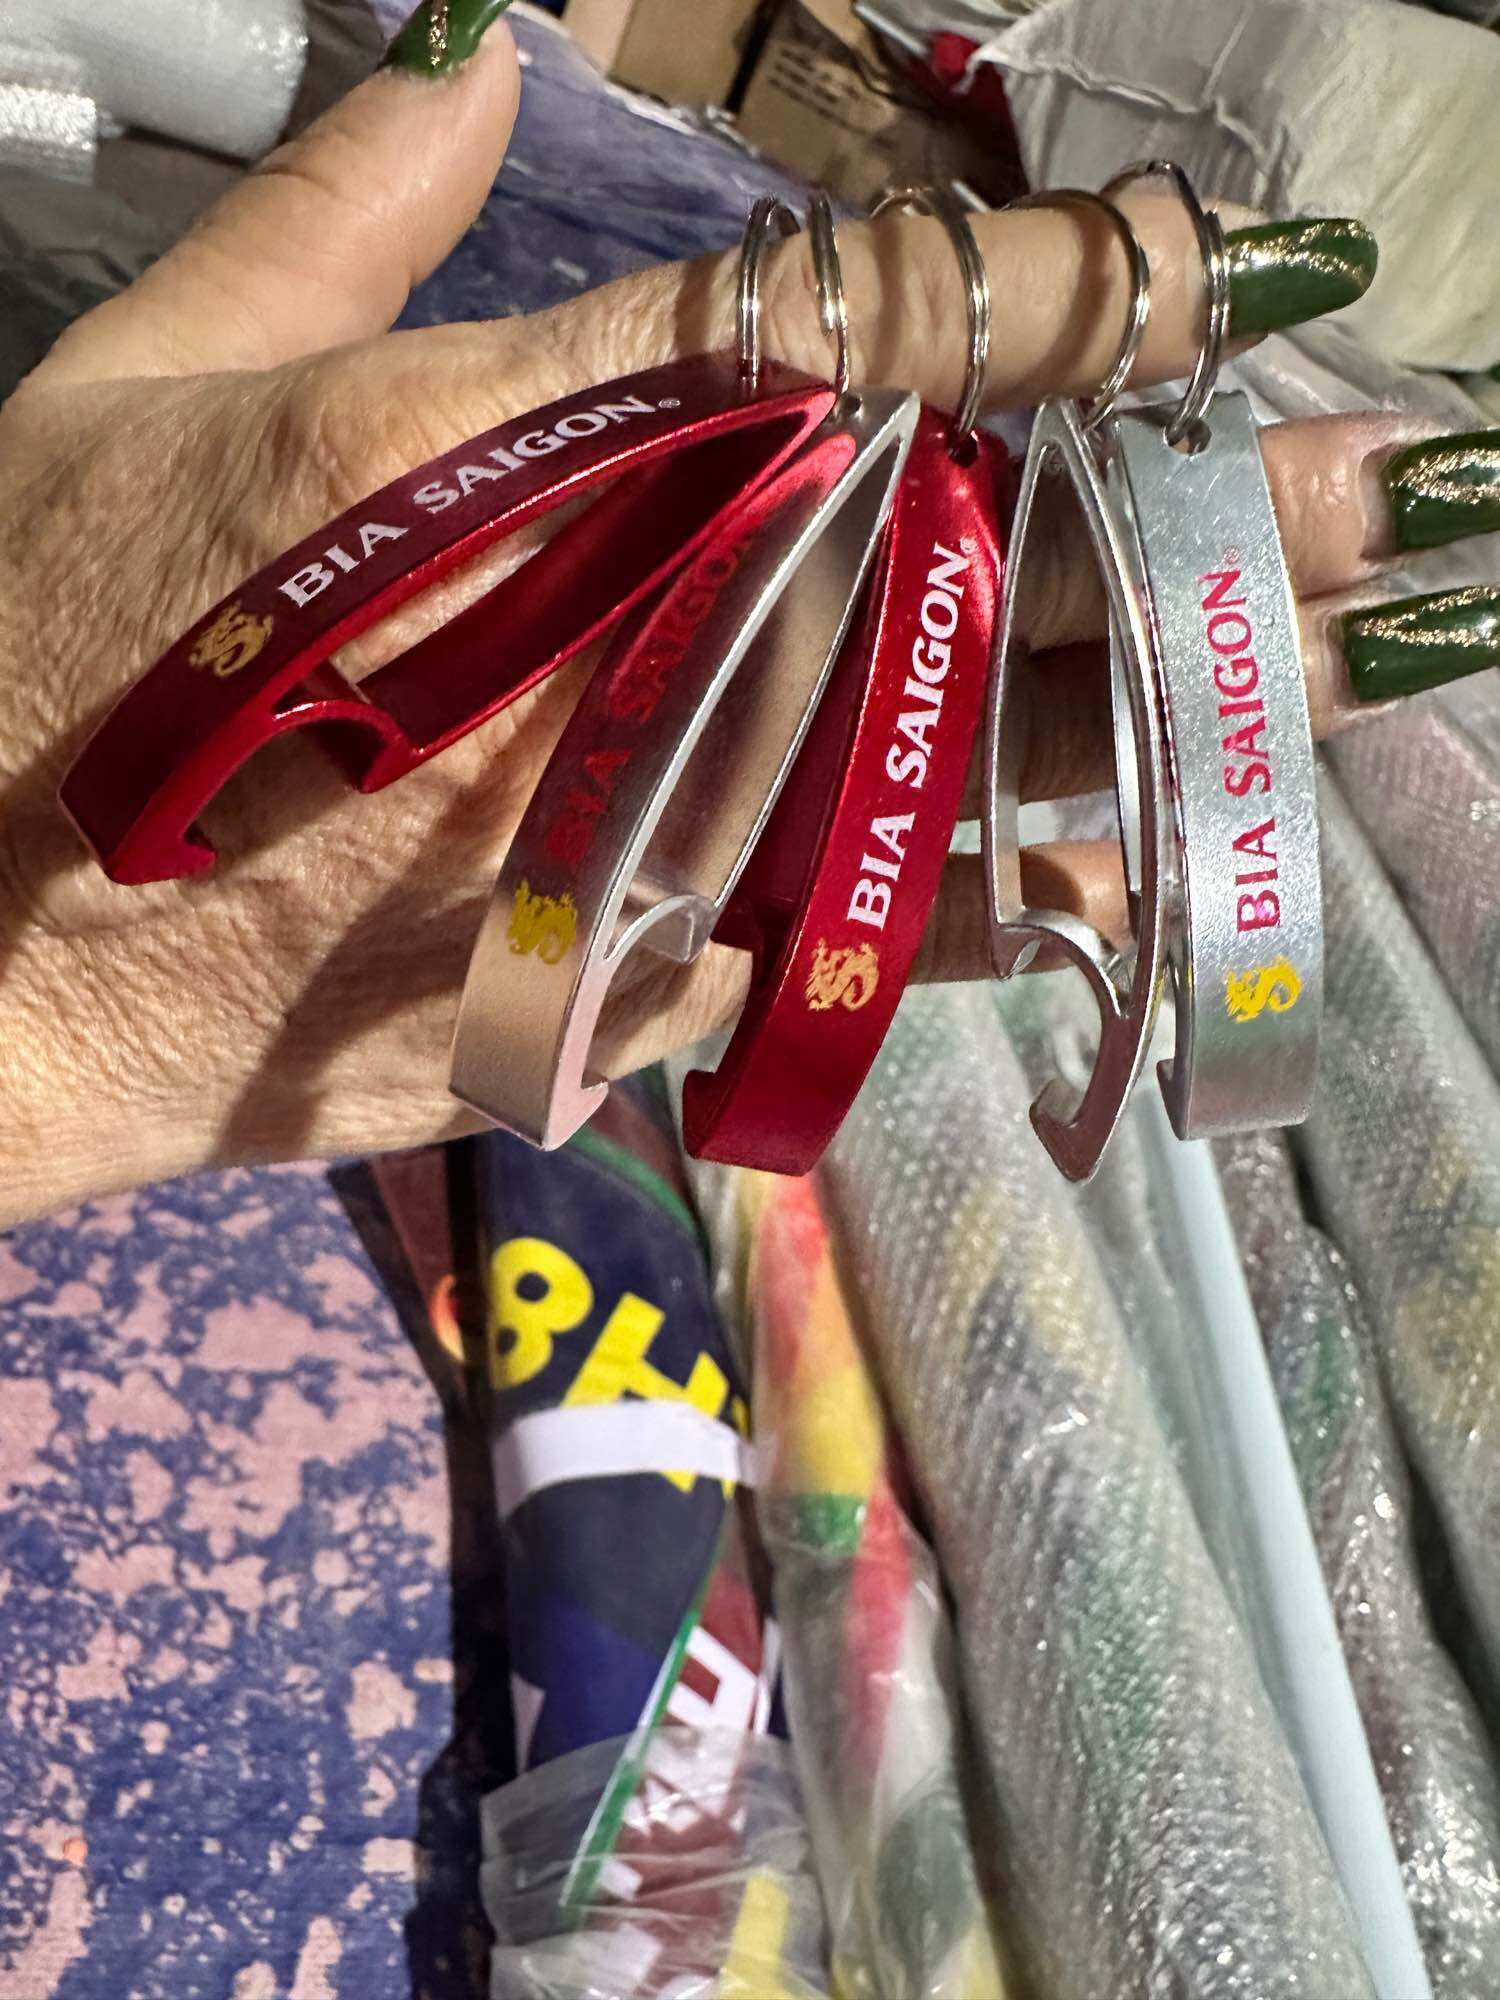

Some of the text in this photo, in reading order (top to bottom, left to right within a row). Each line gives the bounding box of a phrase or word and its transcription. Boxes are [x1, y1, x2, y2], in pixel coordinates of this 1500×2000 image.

[278, 521, 409, 607] BIA
[545, 749, 632, 865] BIA
[847, 812, 915, 931] BIA
[1235, 817, 1281, 933] BIA
